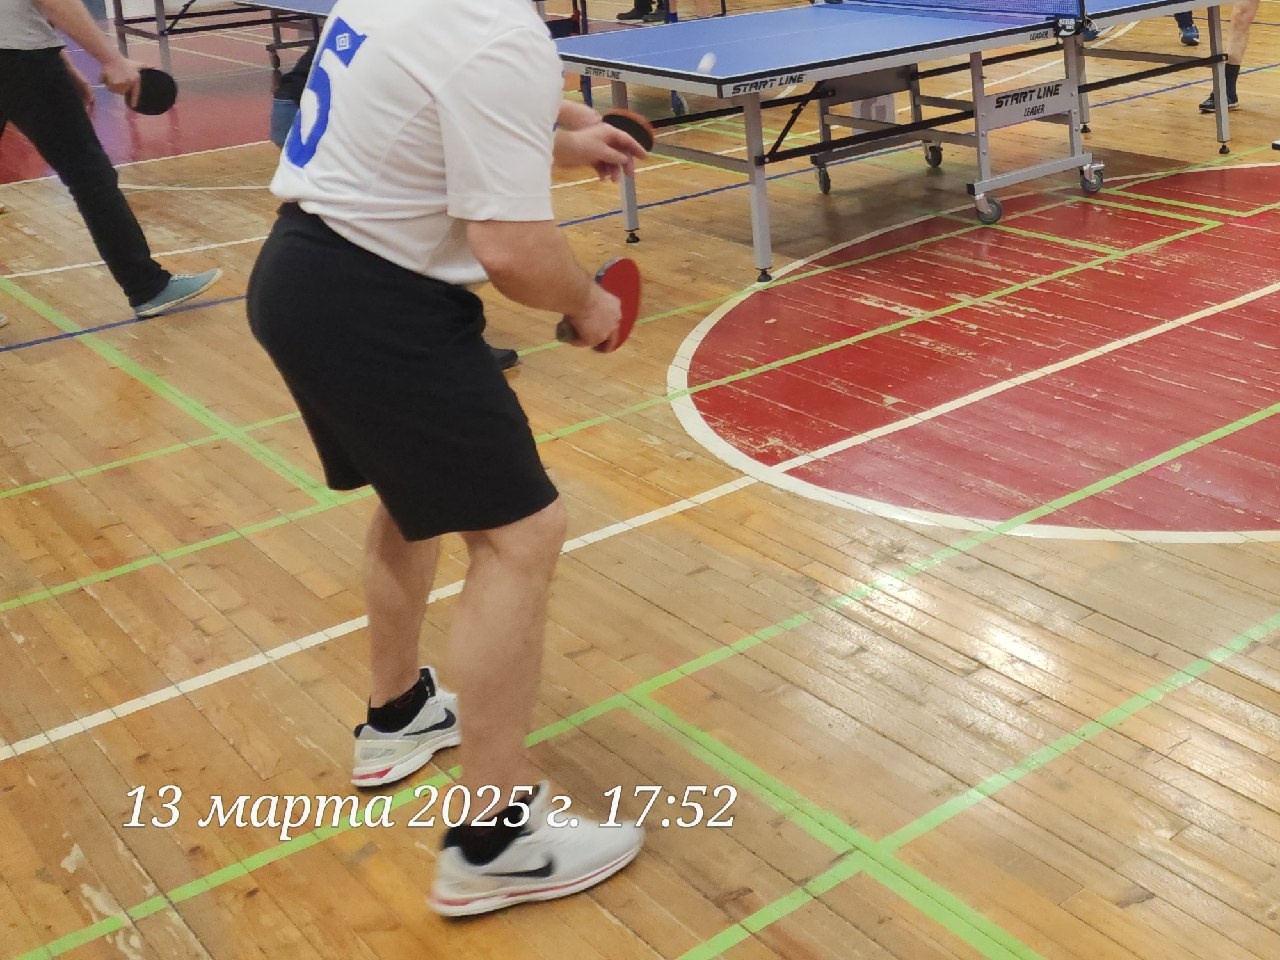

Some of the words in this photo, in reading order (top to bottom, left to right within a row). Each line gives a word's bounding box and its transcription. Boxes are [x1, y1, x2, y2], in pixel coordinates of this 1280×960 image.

[1029, 30, 1049, 41] LEADER
[584, 66, 606, 77] START
[606, 70, 621, 80] LINE
[731, 77, 776, 95] START
[777, 73, 805, 85] LINE
[994, 89, 1036, 109] START
[1036, 83, 1062, 100] LINE
[1023, 104, 1046, 117] LEADER
